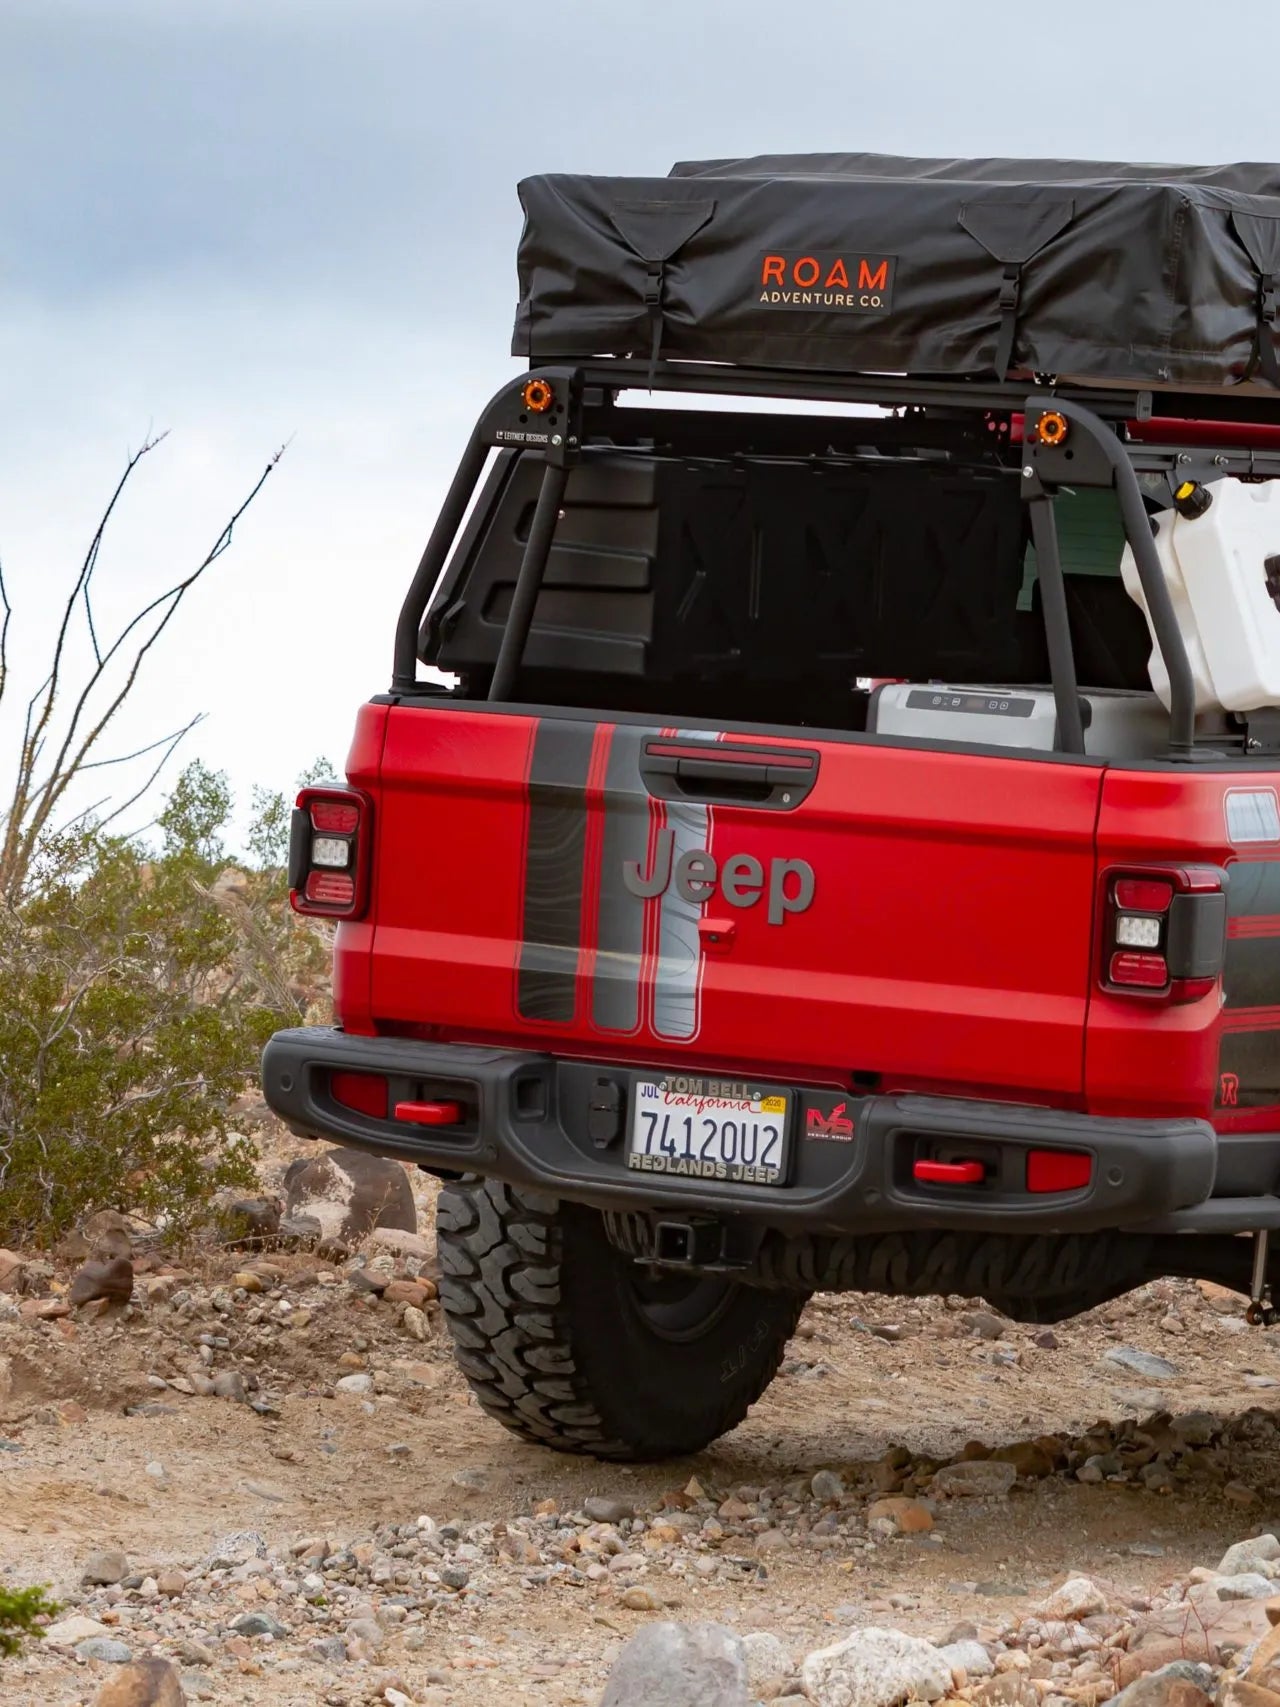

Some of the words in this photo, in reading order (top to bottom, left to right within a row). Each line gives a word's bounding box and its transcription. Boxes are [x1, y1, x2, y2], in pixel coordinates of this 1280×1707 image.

[762, 256, 888, 290] ROAM
[760, 291, 854, 306] ADVENTURE
[860, 295, 884, 308] CO.
[622, 827, 815, 925] Jeep
[641, 1085, 659, 1099] JUL
[665, 1076, 703, 1095] TOM
[708, 1081, 752, 1100] BELL
[664, 1090, 761, 1115] California
[641, 1111, 778, 1168] 74120U2
[628, 1152, 727, 1179] REDLANDS
[732, 1165, 780, 1183] JEEP
